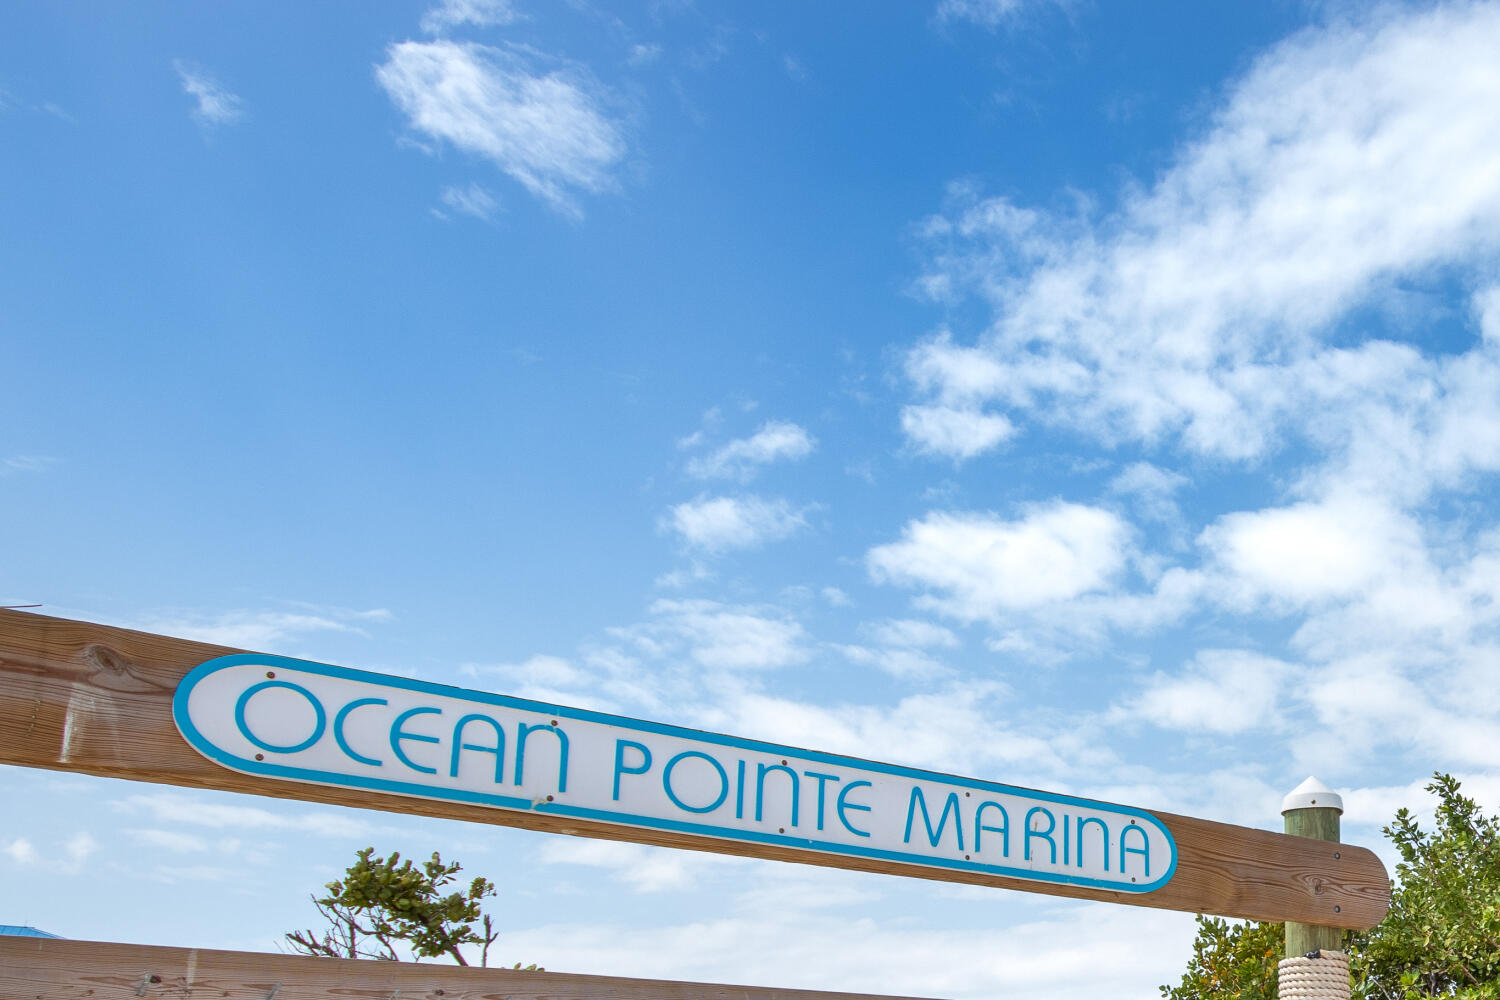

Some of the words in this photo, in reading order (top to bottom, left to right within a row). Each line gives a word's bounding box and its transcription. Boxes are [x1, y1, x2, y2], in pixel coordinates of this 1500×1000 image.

[234, 680, 570, 794] OCEAN
[612, 739, 873, 838] POINTE
[903, 785, 1151, 878] MARINA
